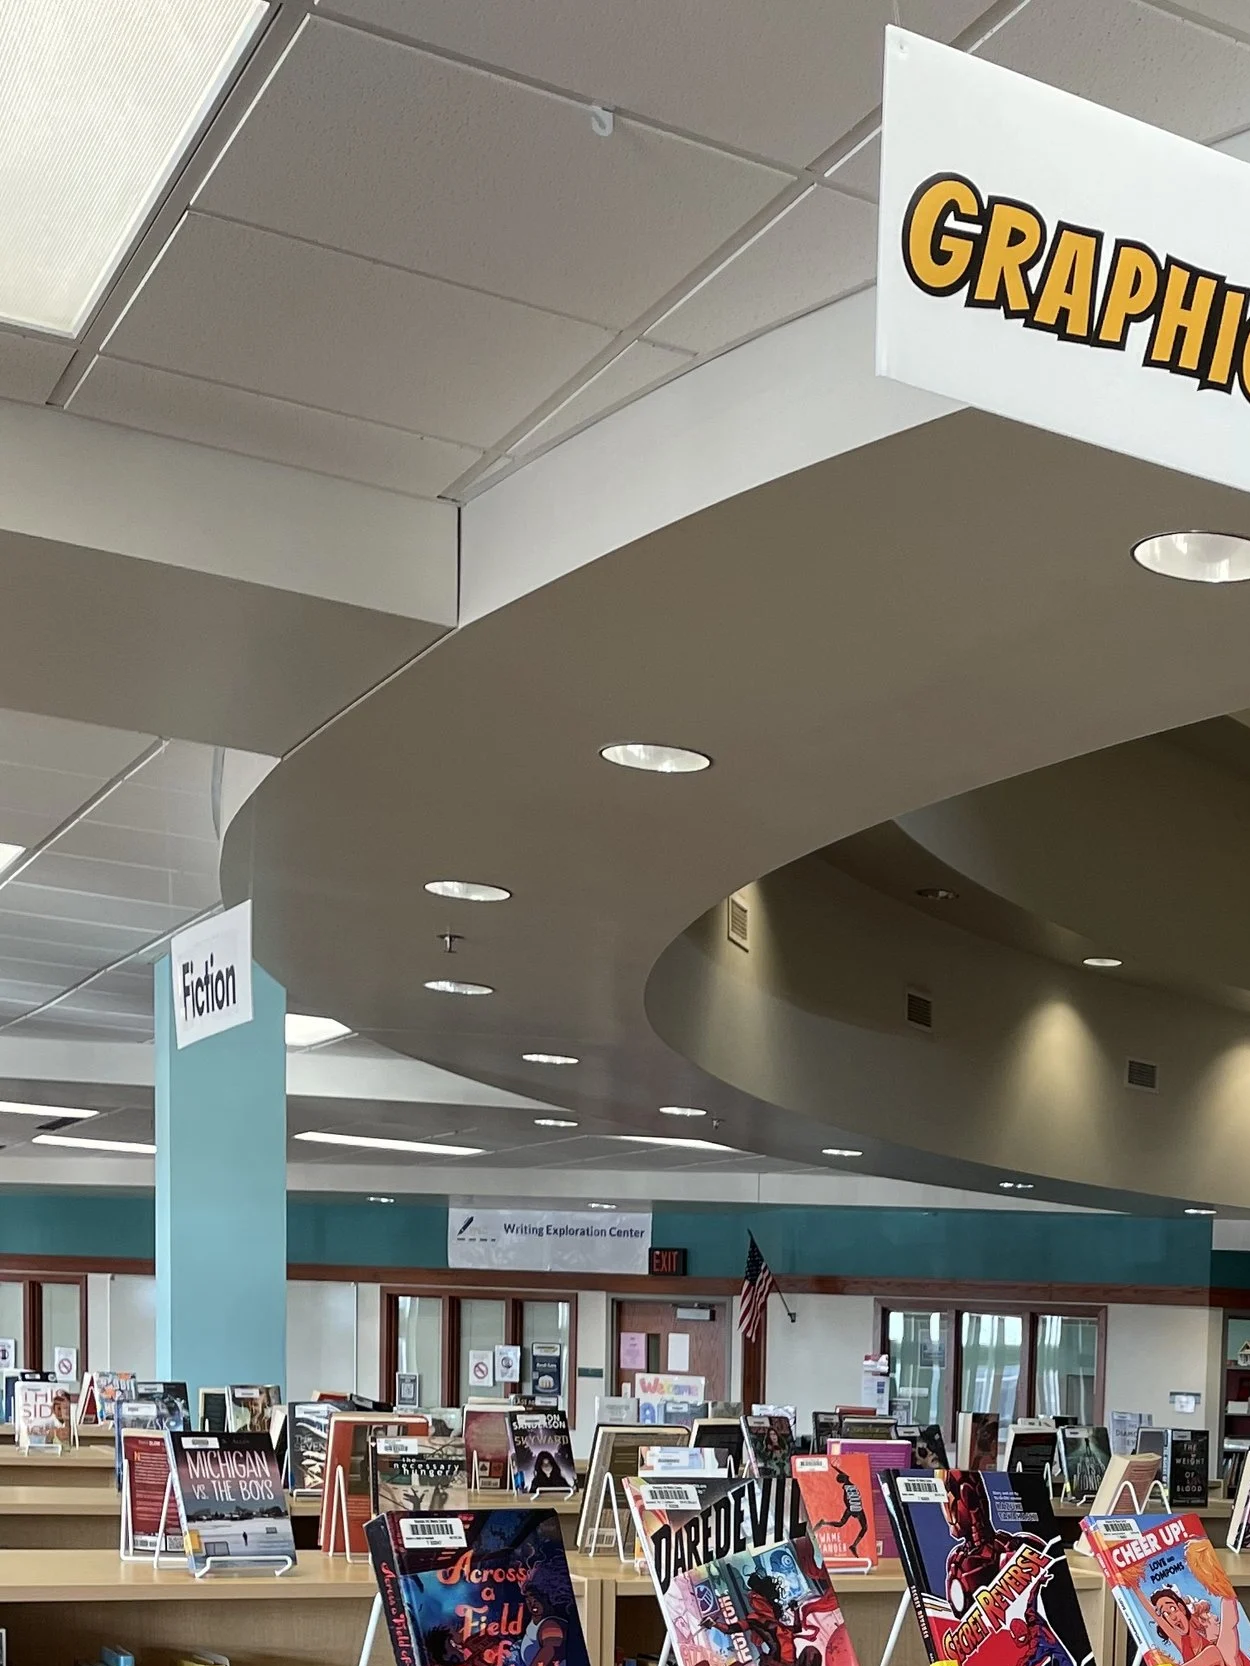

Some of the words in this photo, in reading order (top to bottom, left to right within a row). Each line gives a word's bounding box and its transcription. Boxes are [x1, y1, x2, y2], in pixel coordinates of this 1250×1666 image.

[182, 952, 236, 1022] Fiction
[504, 1223, 543, 1237] Writing
[546, 1225, 606, 1238] Exploration
[609, 1226, 645, 1238] Center
[653, 1251, 679, 1272] EXIT
[512, 1421, 566, 1430] SANDERSON
[514, 1435, 569, 1446] SKYWARD
[186, 1451, 271, 1479] MICHIGAN
[393, 1463, 459, 1473] necessary
[403, 1468, 450, 1478] hunger
[211, 1481, 235, 1502] THE
[240, 1480, 274, 1500] BOYS
[1177, 1485, 1202, 1493] BLOOD
[651, 1478, 808, 1595] DAREDEVIL
[1112, 1536, 1159, 1568] CHEER
[1160, 1520, 1189, 1546] UP!
[438, 1550, 528, 1585] Across
[1149, 1557, 1167, 1572] LOVE
[1150, 1562, 1185, 1584] POMPOMS
[481, 1587, 496, 1601] a
[976, 1545, 1050, 1632] REVERSE
[455, 1603, 523, 1642] Field
[943, 1609, 991, 1664] SECRET
